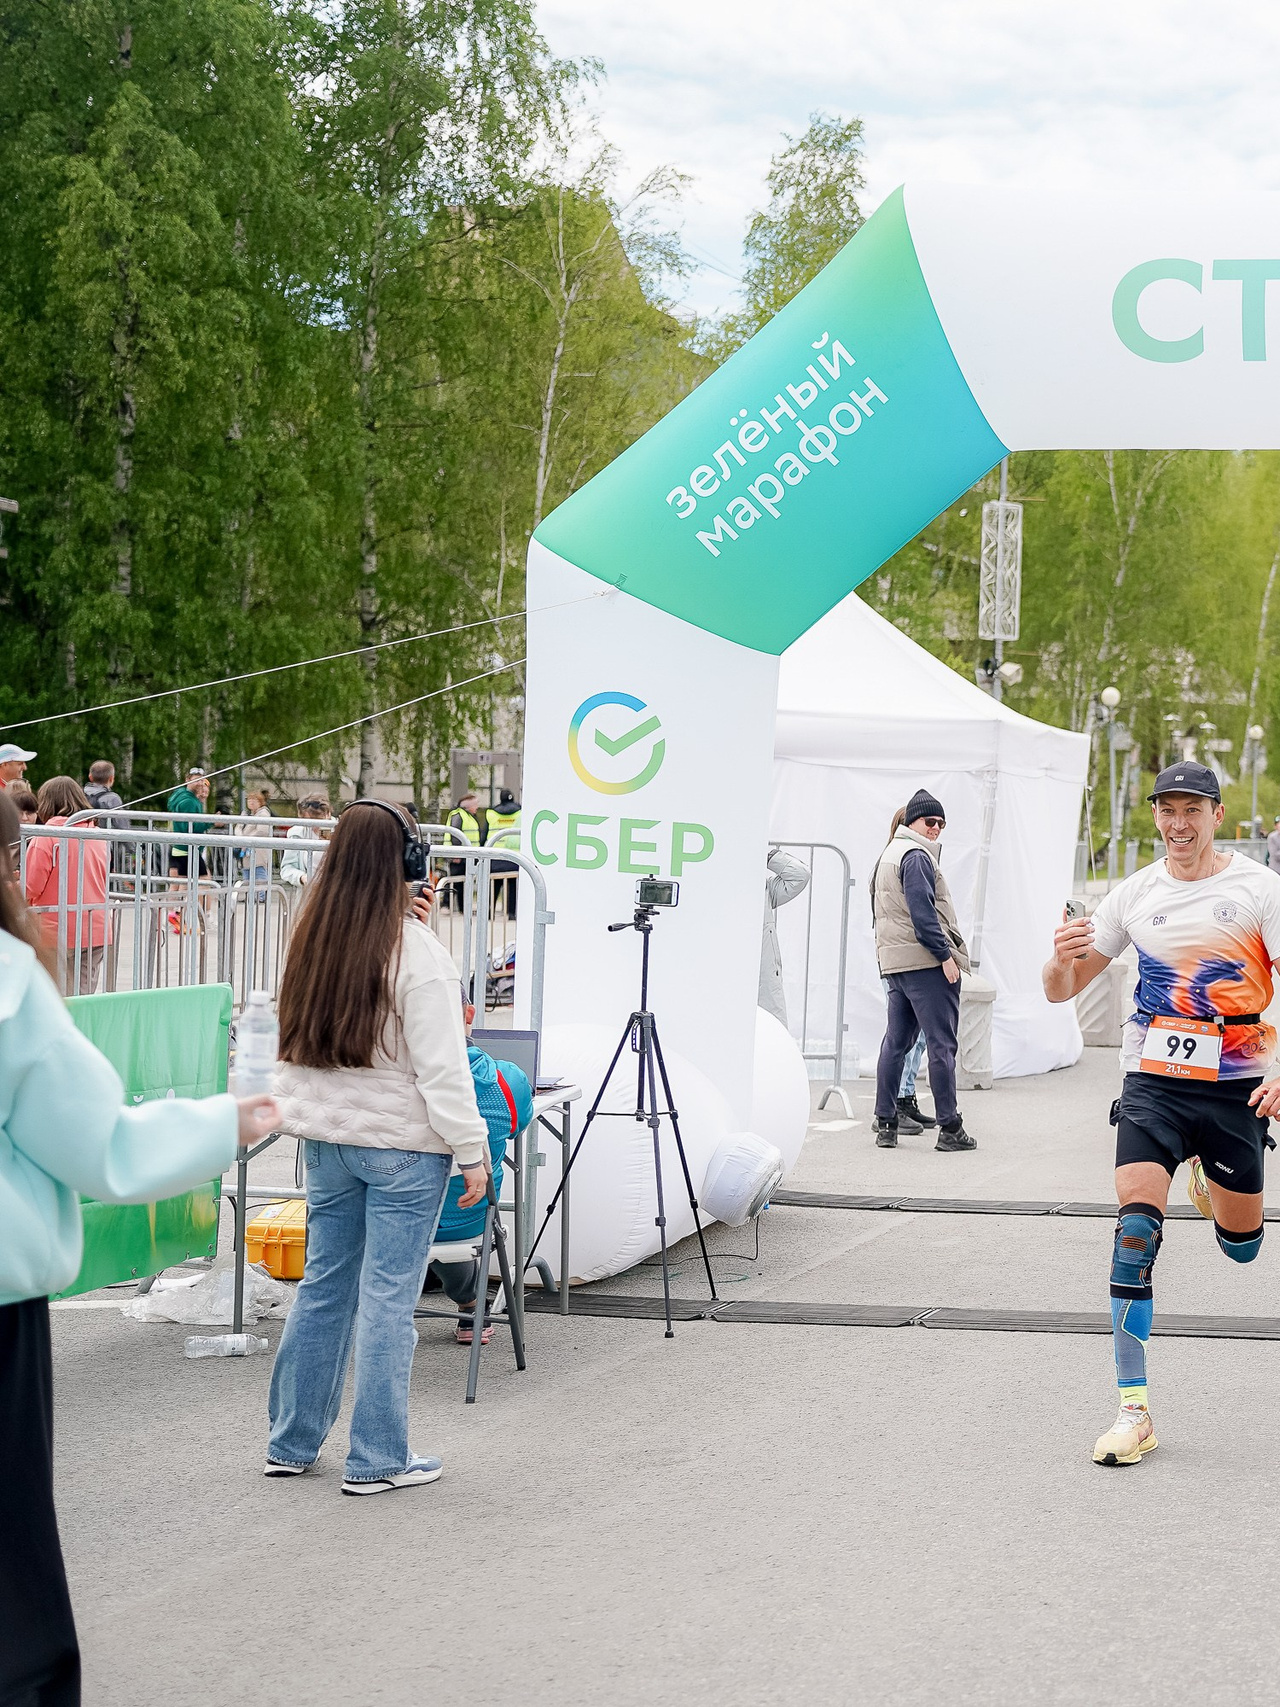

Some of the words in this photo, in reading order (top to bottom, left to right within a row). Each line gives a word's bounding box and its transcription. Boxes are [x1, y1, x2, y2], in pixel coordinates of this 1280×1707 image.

[665, 331, 857, 519] зелёный
[695, 376, 890, 558] марафон
[530, 809, 715, 877] СБЕР
[1166, 1035, 1197, 1060] 99
